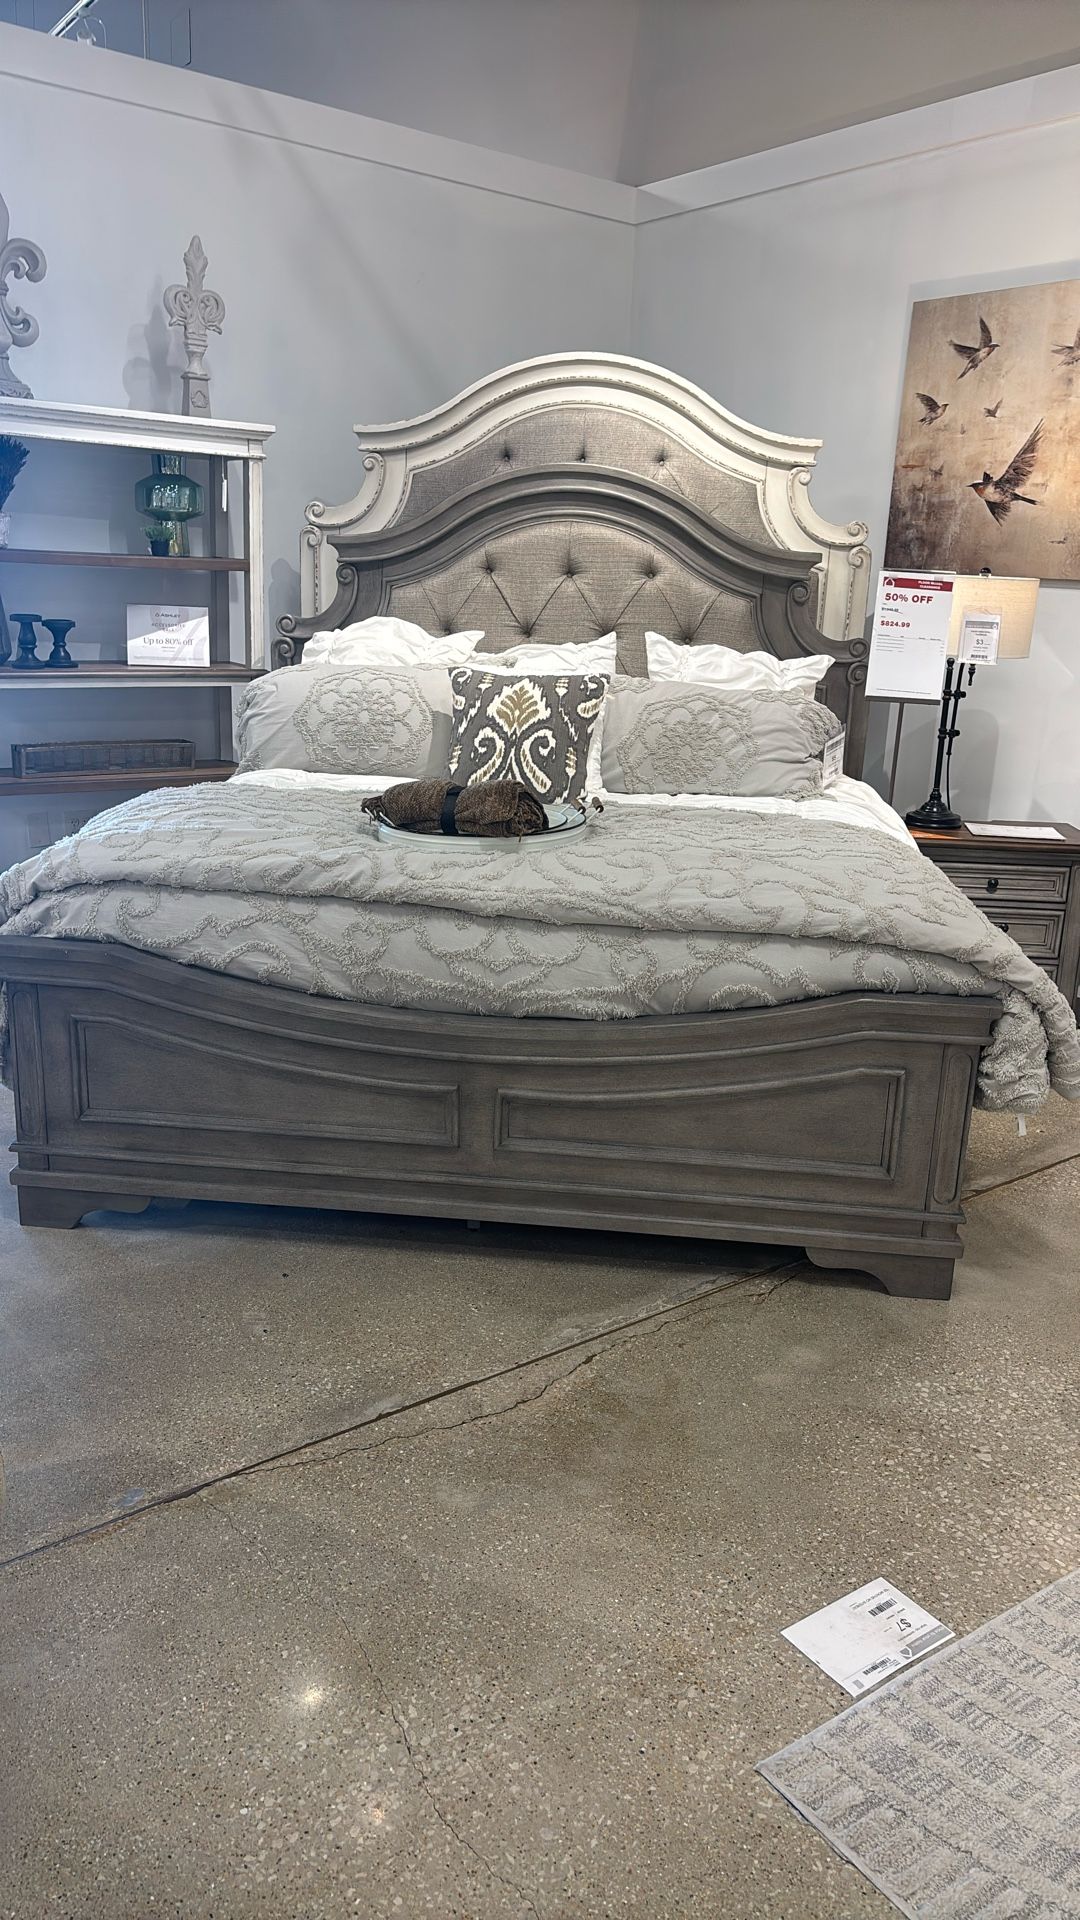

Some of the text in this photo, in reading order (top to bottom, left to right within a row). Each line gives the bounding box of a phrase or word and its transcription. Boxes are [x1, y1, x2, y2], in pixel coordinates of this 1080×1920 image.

[885, 593, 934, 604] 50% OFF
[880, 620, 911, 628] $824.99
[143, 637, 154, 645] Up
[165, 637, 181, 645] 80%
[183, 638, 193, 646] off
[896, 1617, 912, 1632] $7
